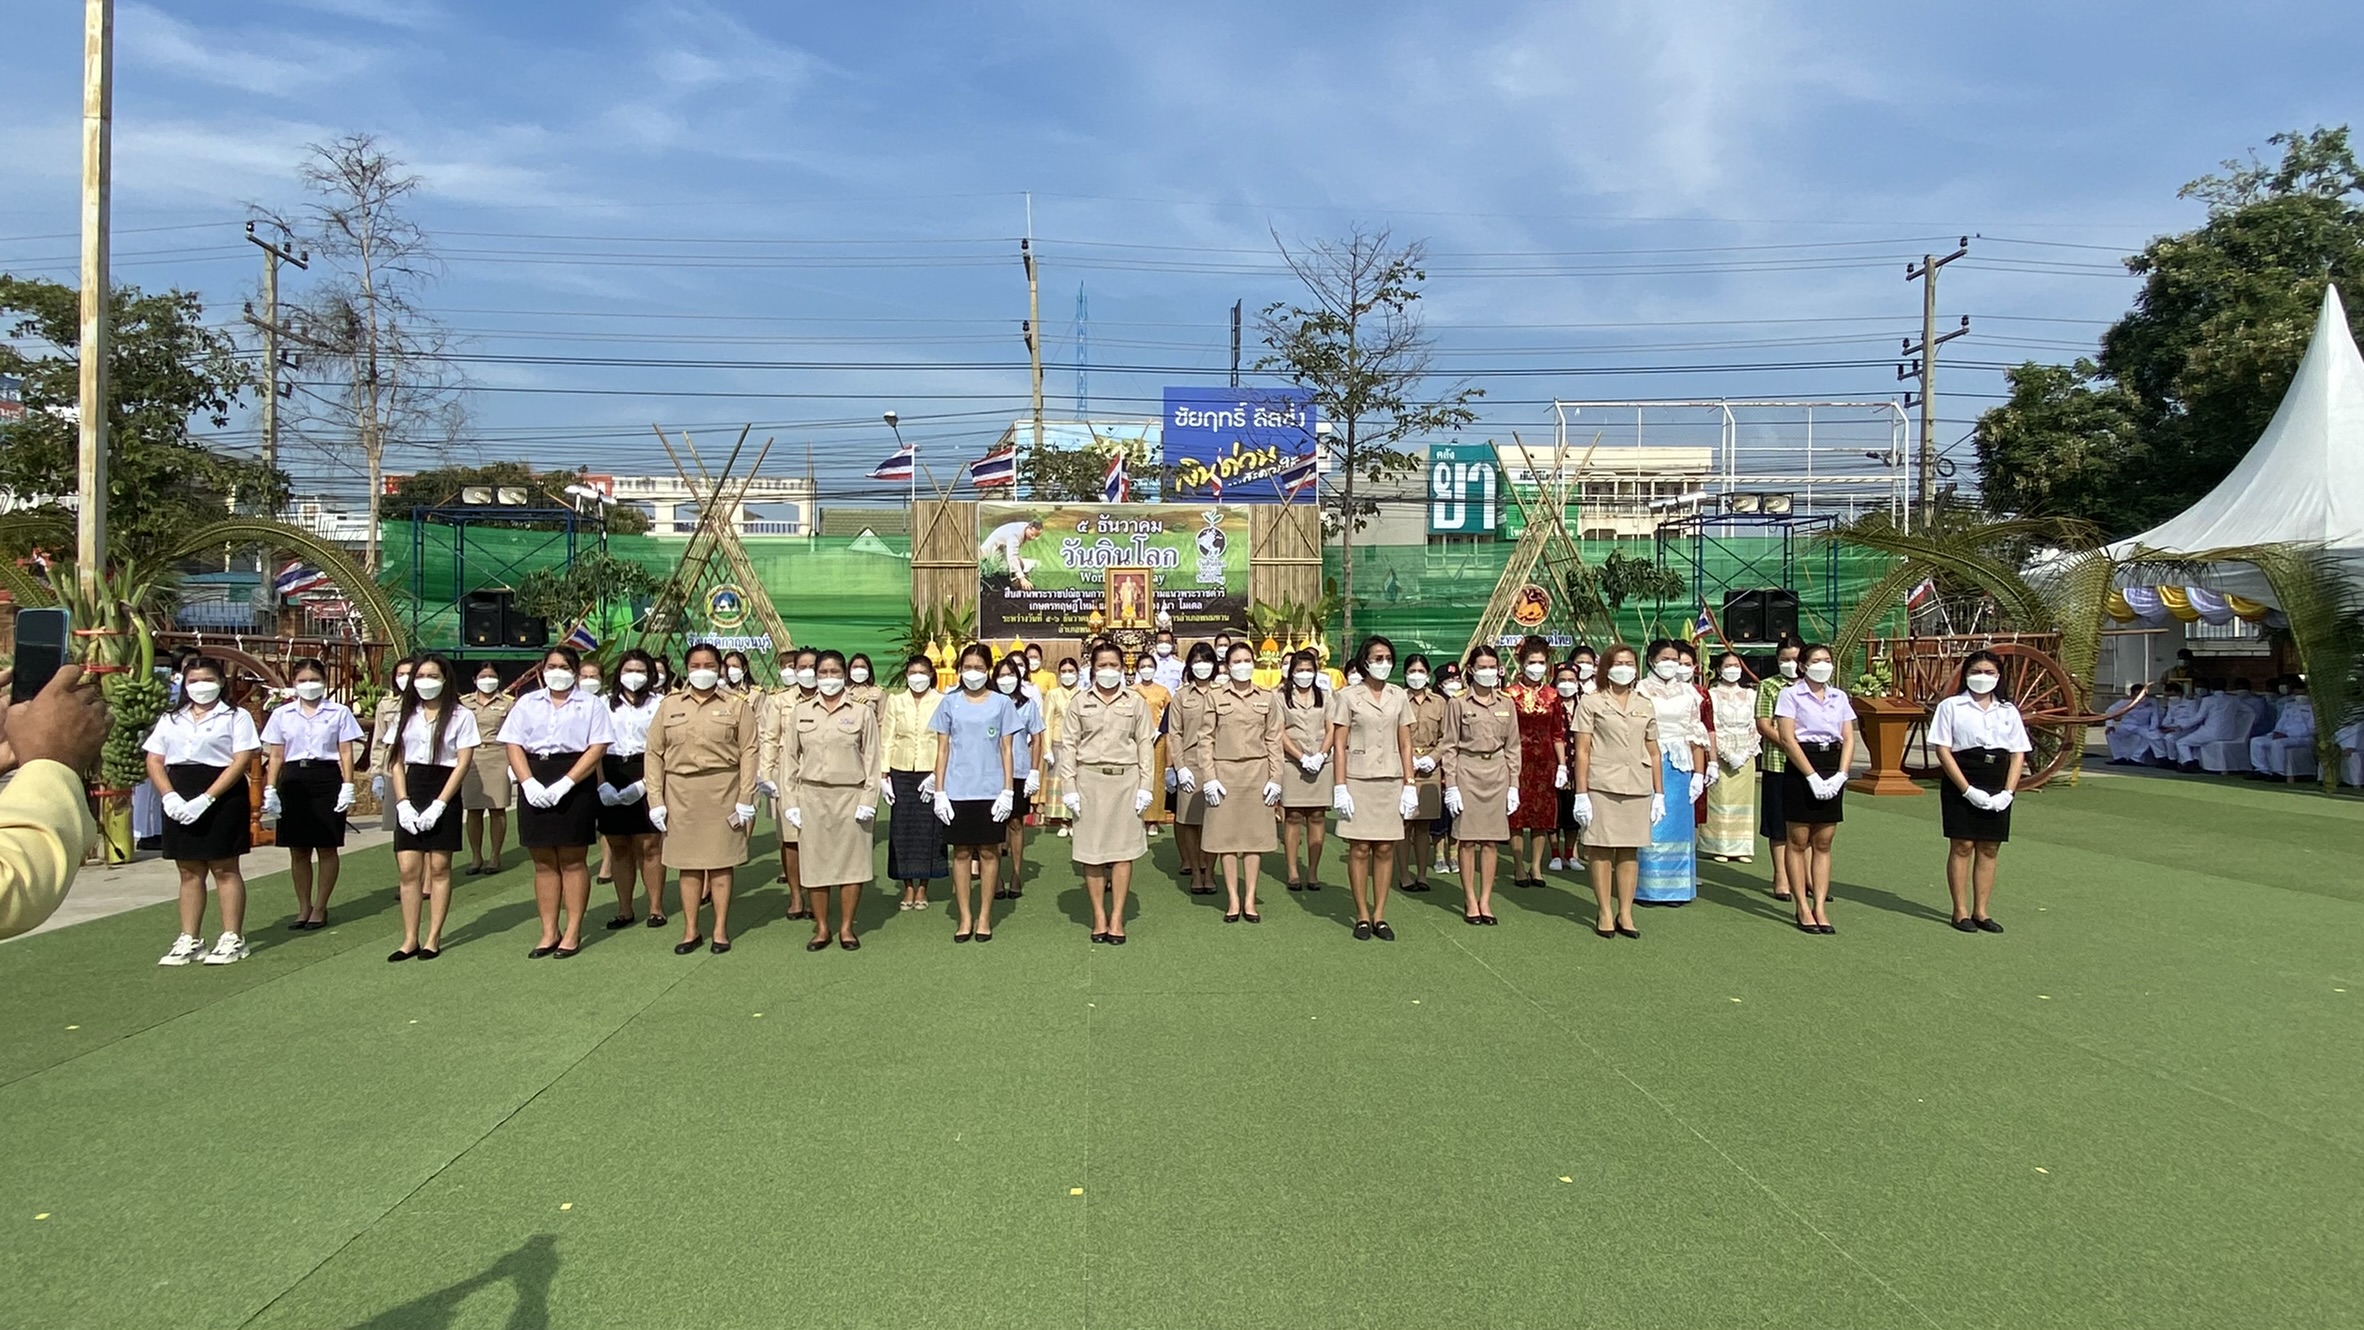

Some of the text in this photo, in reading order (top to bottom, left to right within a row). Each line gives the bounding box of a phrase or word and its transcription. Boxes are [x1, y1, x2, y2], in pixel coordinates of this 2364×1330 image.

[1436, 448, 1455, 459] คลัง
[1433, 461, 1496, 530] ยา
[1077, 514, 1162, 533] ๕ ธันวาคม
[1062, 533, 1178, 568] วันดินโลก
[1080, 571, 1165, 585] Worl ay
[1004, 586, 1105, 599] สืบสานพระราชปณิธานการ
